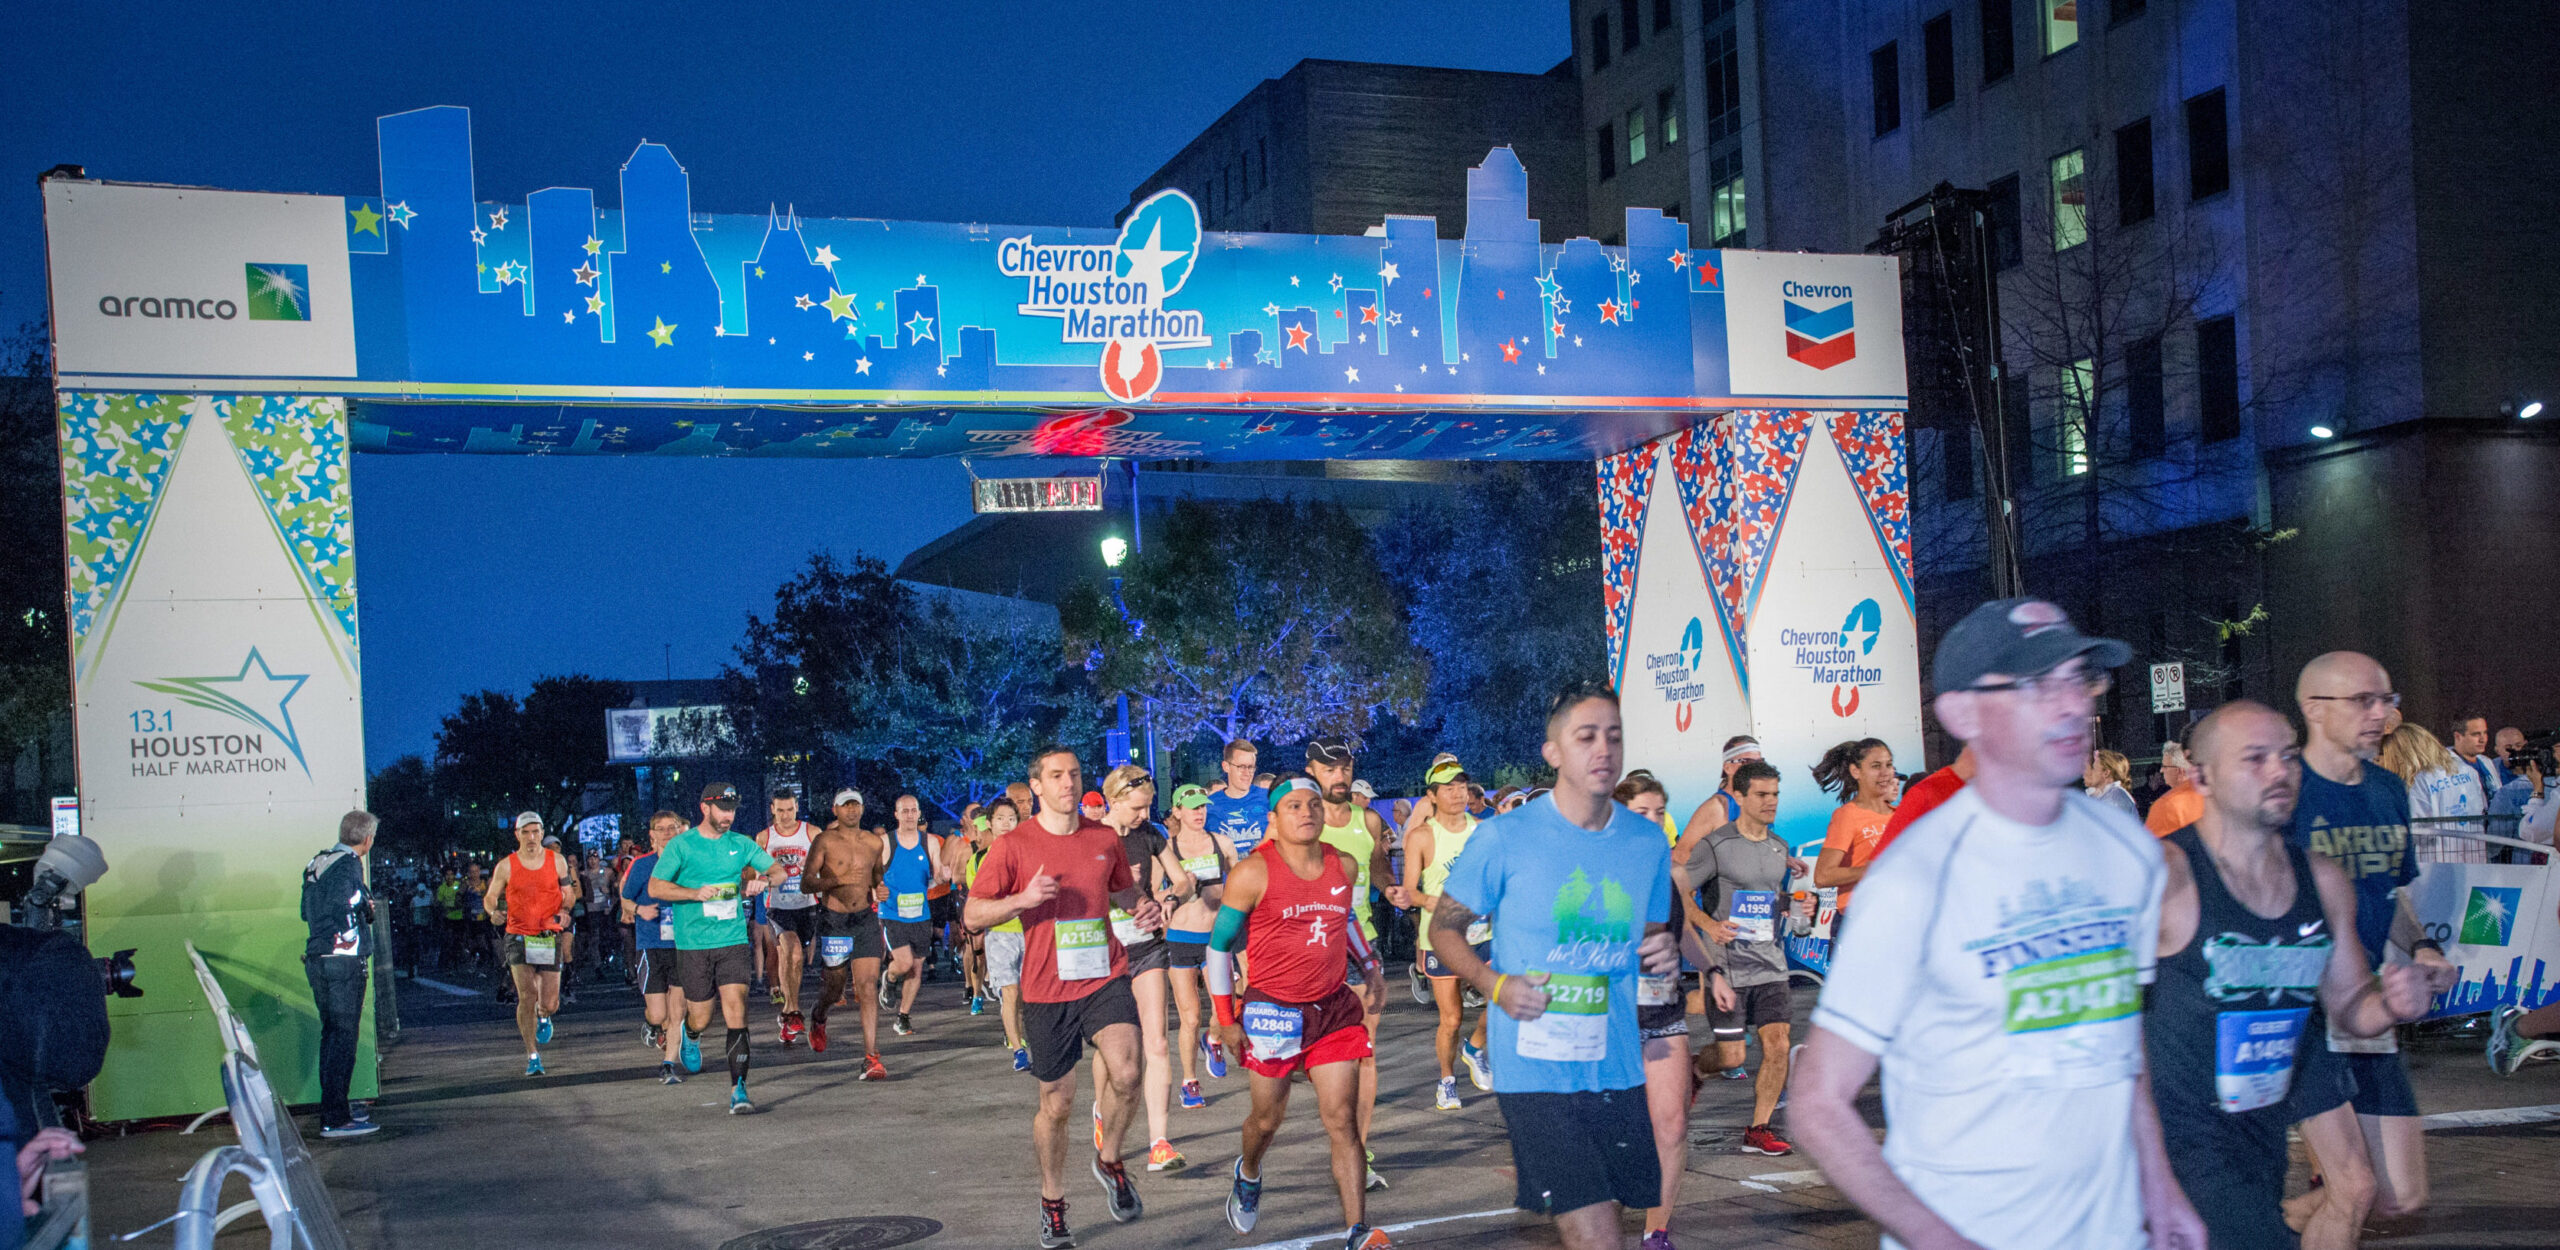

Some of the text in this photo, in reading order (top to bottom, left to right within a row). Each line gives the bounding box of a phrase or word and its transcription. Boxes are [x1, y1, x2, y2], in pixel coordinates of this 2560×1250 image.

[1002, 242, 1113, 272] Chevron
[1033, 275, 1148, 305] Houston
[1783, 281, 1852, 298] Chevron
[99, 296, 237, 320] aramco
[1067, 307, 1199, 338] Marathon
[1781, 628, 1838, 646] Chevron
[1646, 651, 1679, 670] Chevron
[1796, 647, 1856, 665] Houston
[1655, 666, 1689, 687] Houston
[1813, 665, 1882, 683] Marathon
[1665, 683, 1704, 703] Marathon
[129, 709, 173, 732] 13.1
[131, 734, 262, 758] HOUSTON
[132, 757, 286, 777] HALF MARATHON
[2346, 851, 2404, 879] IPS
[1282, 901, 1346, 919] El Jarrito.com
[1738, 904, 1770, 914] A1950
[1547, 933, 1633, 970] the Park
[1533, 984, 1606, 1004] 22719
[1245, 1006, 1279, 1016] EDUARDO
[1251, 1018, 1293, 1032] A2848
